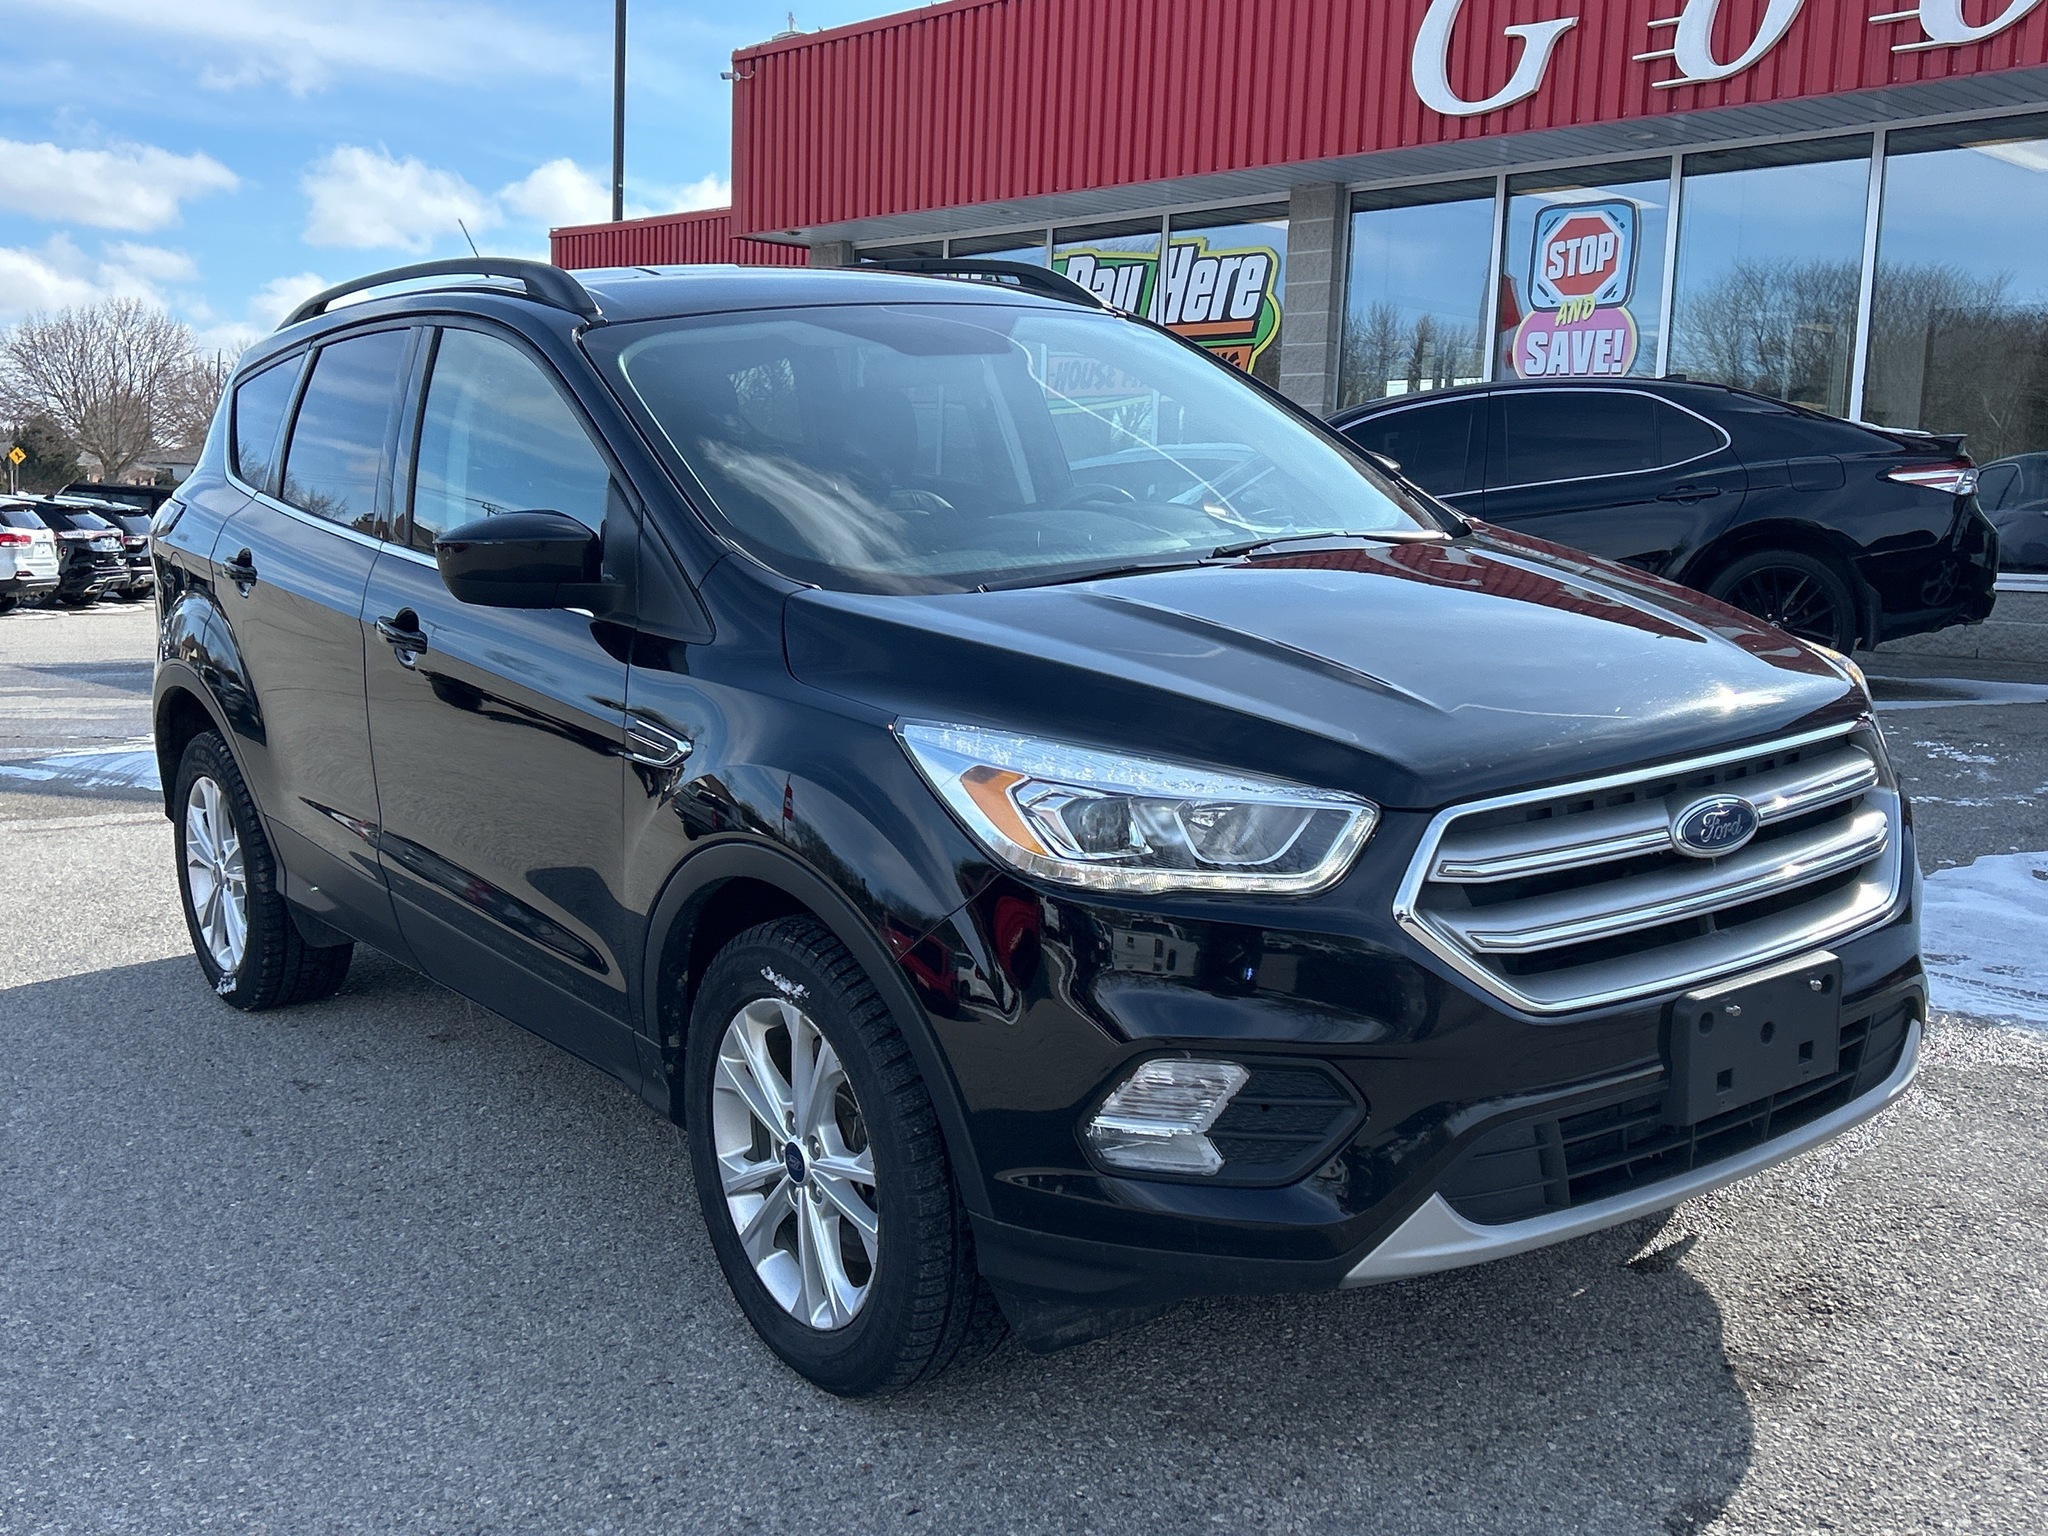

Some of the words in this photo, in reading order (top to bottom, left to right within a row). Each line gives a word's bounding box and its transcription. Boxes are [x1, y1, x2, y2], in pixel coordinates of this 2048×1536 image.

[1548, 232, 1615, 280] STOP
[1148, 246, 1268, 324] Here
[1555, 294, 1596, 327] AND
[1524, 329, 1625, 376] SAVE!
[1700, 809, 1743, 843] Ford
